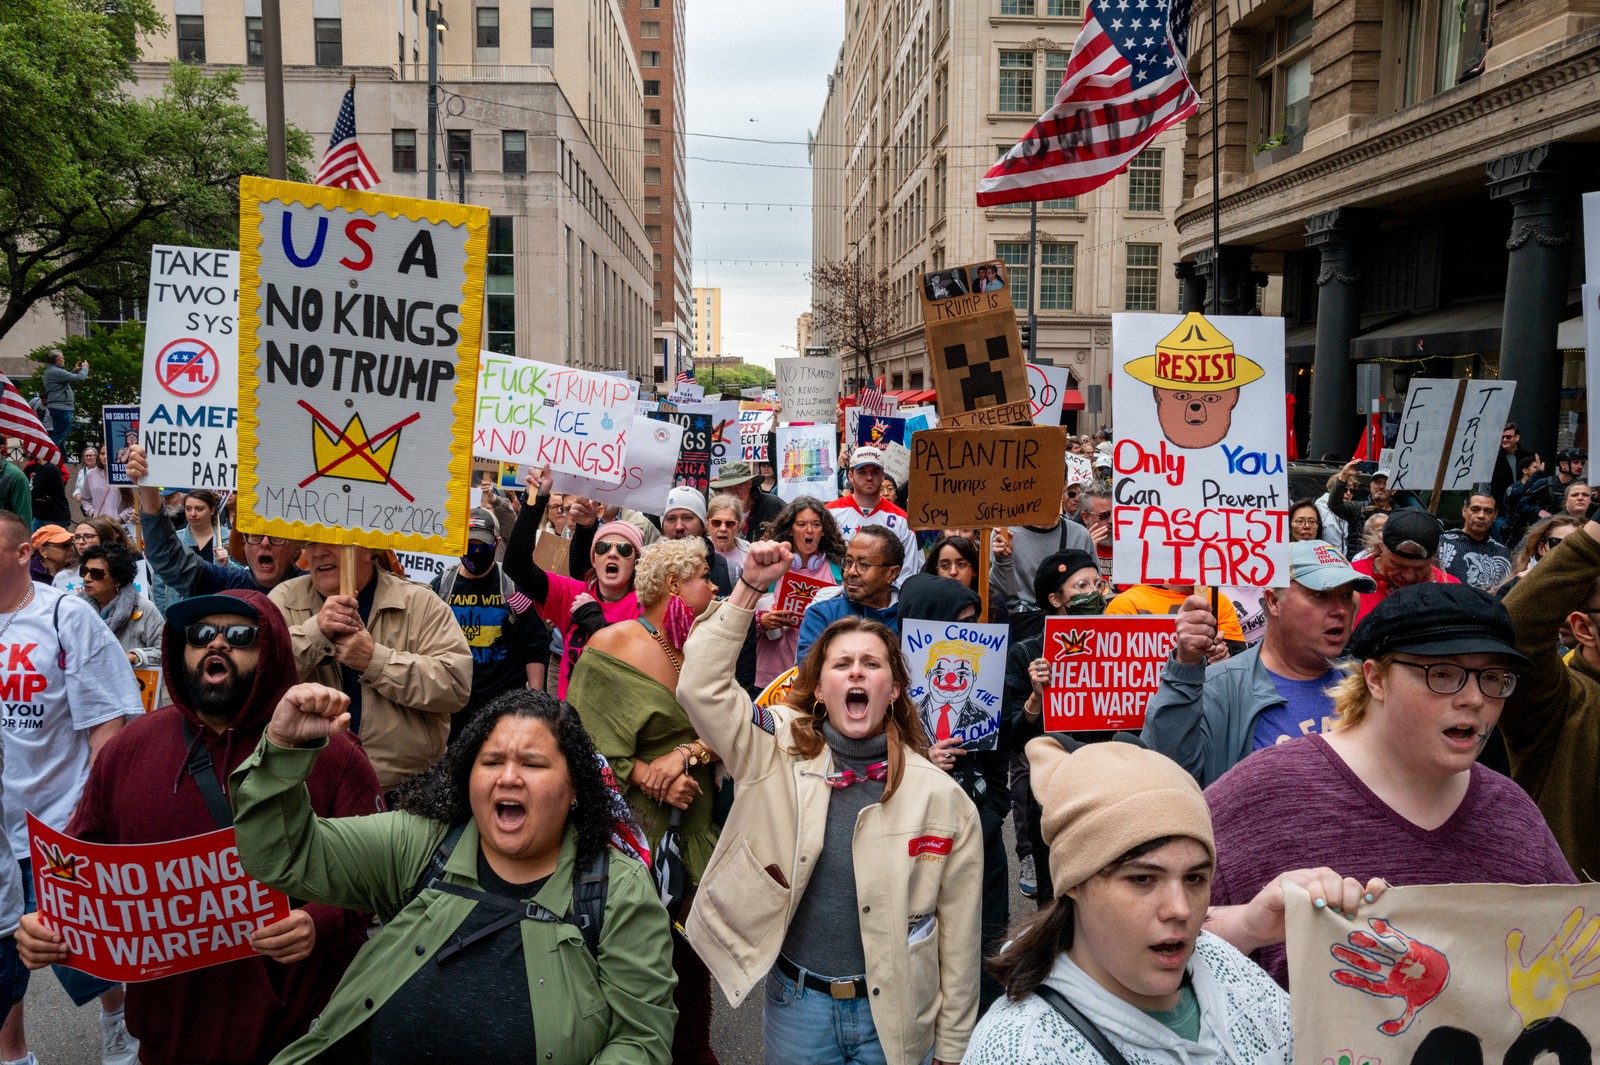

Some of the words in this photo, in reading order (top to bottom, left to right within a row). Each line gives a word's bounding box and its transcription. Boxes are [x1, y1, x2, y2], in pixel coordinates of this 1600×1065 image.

[155, 250, 229, 278] TAKE
[154, 283, 225, 305] TWO
[932, 295, 981, 320] TRUMP
[987, 293, 998, 309] IS
[186, 312, 238, 335] SYS
[267, 283, 323, 332] NO
[333, 291, 459, 347] KINGS
[267, 340, 324, 388] NO
[329, 347, 455, 402] TRUMP
[780, 365, 797, 383] NO
[1157, 352, 1235, 382] RESIST
[482, 359, 548, 398] FUCK
[550, 370, 630, 408] TRUMP
[781, 386, 795, 397] NO
[477, 396, 546, 429] FUCK
[553, 409, 590, 435] ICE
[668, 413, 691, 431] NO
[145, 431, 201, 457] NEEDS
[214, 434, 228, 458] A
[1114, 438, 1185, 486] Only
[1000, 476, 1037, 493] Secret
[1114, 477, 1161, 507] Can
[1202, 479, 1279, 508] Prevent
[266, 486, 365, 527] MARCH
[404, 507, 444, 537] 2026
[886, 514, 897, 529] C
[919, 502, 949, 526] Spy
[975, 498, 1043, 521] Software
[1113, 505, 1289, 544] FASCIST
[1140, 540, 1275, 587] LIARS
[945, 624, 1005, 652] CROWN
[1096, 632, 1122, 658] NO
[5, 704, 44, 717] YOU
[976, 689, 999, 707] THE
[1050, 692, 1084, 718] NOT
[19, 719, 43, 729] HIM
[95, 861, 148, 896] NO
[39, 876, 275, 934] HEALTHCARE
